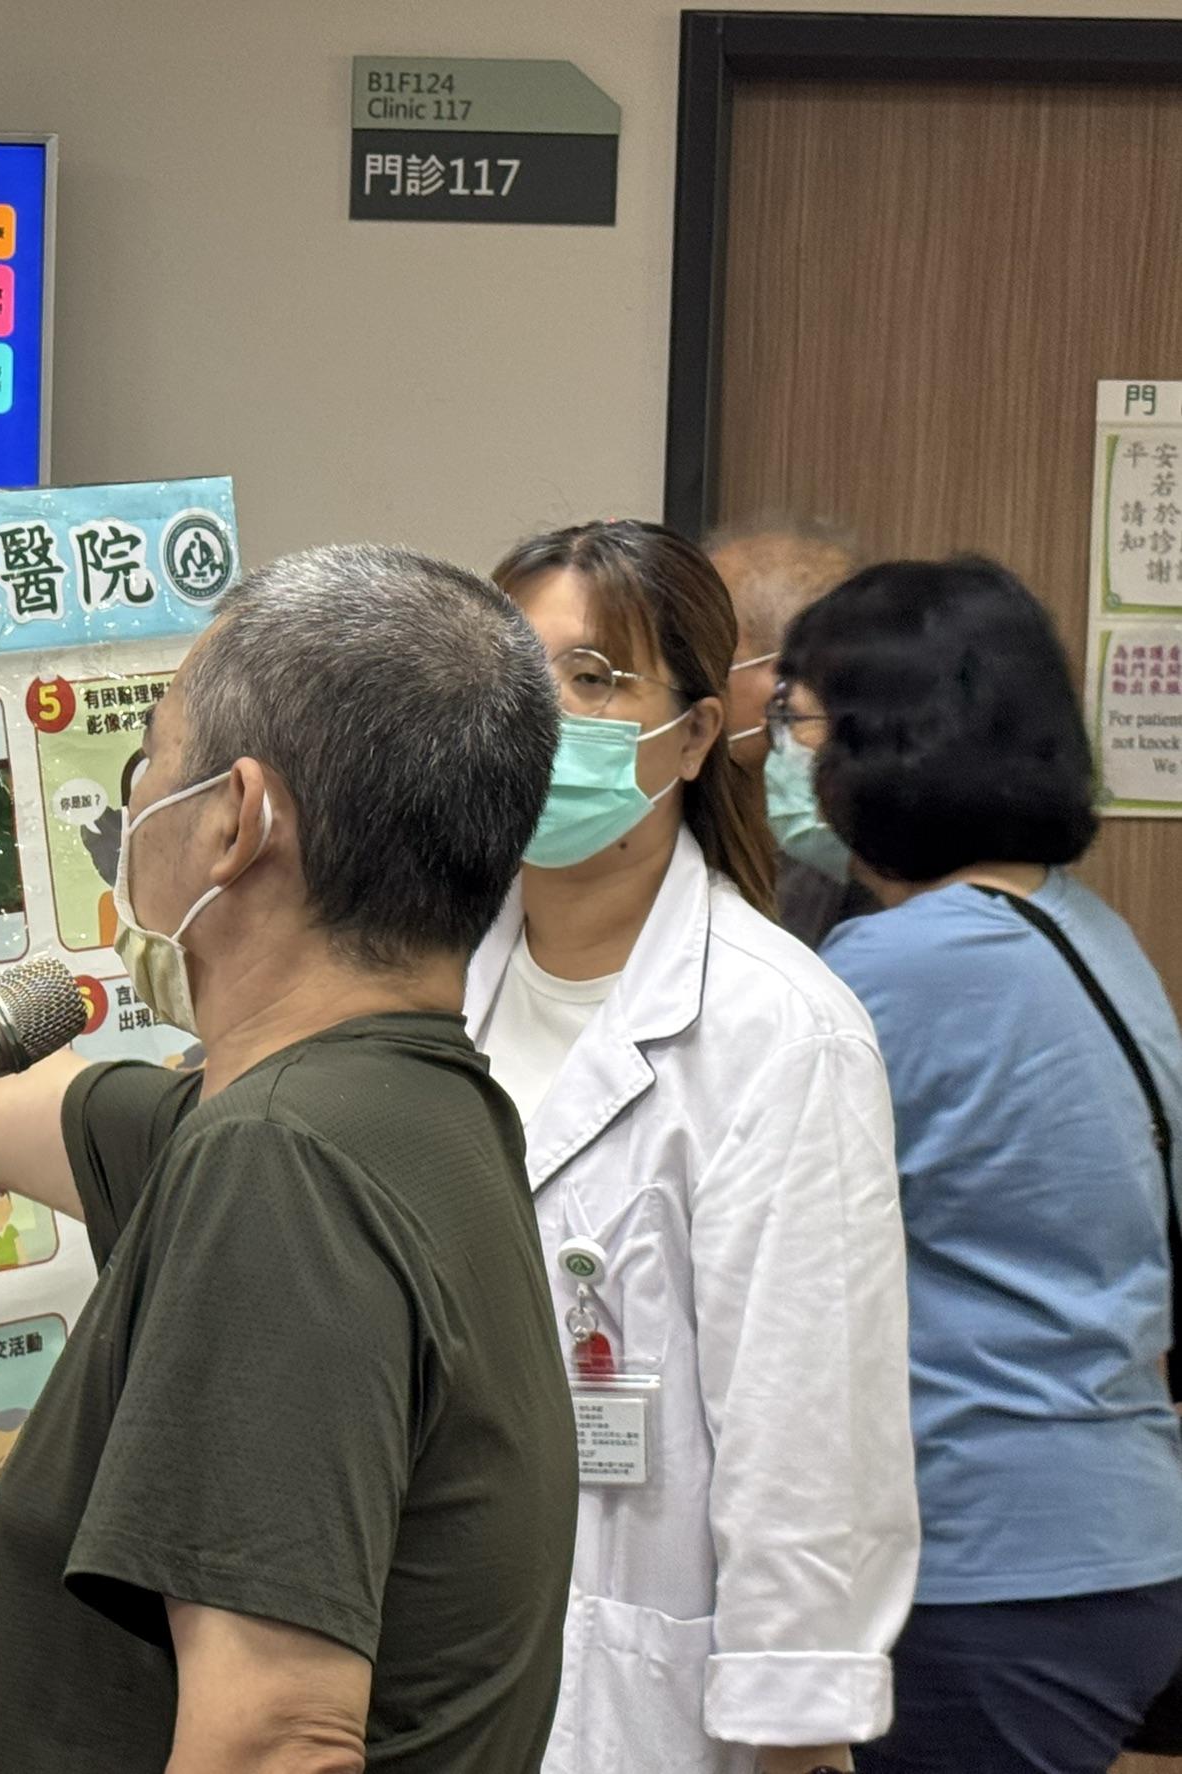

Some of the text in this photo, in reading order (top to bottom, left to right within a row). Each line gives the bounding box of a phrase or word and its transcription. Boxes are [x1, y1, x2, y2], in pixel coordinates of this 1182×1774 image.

[368, 72, 455, 94] B1F124
[368, 98, 472, 121] Clinic 117
[365, 154, 521, 196] 門診117
[1119, 528, 1182, 554] 知診
[39, 685, 61, 721] 5
[84, 682, 171, 709] 有困難理解
